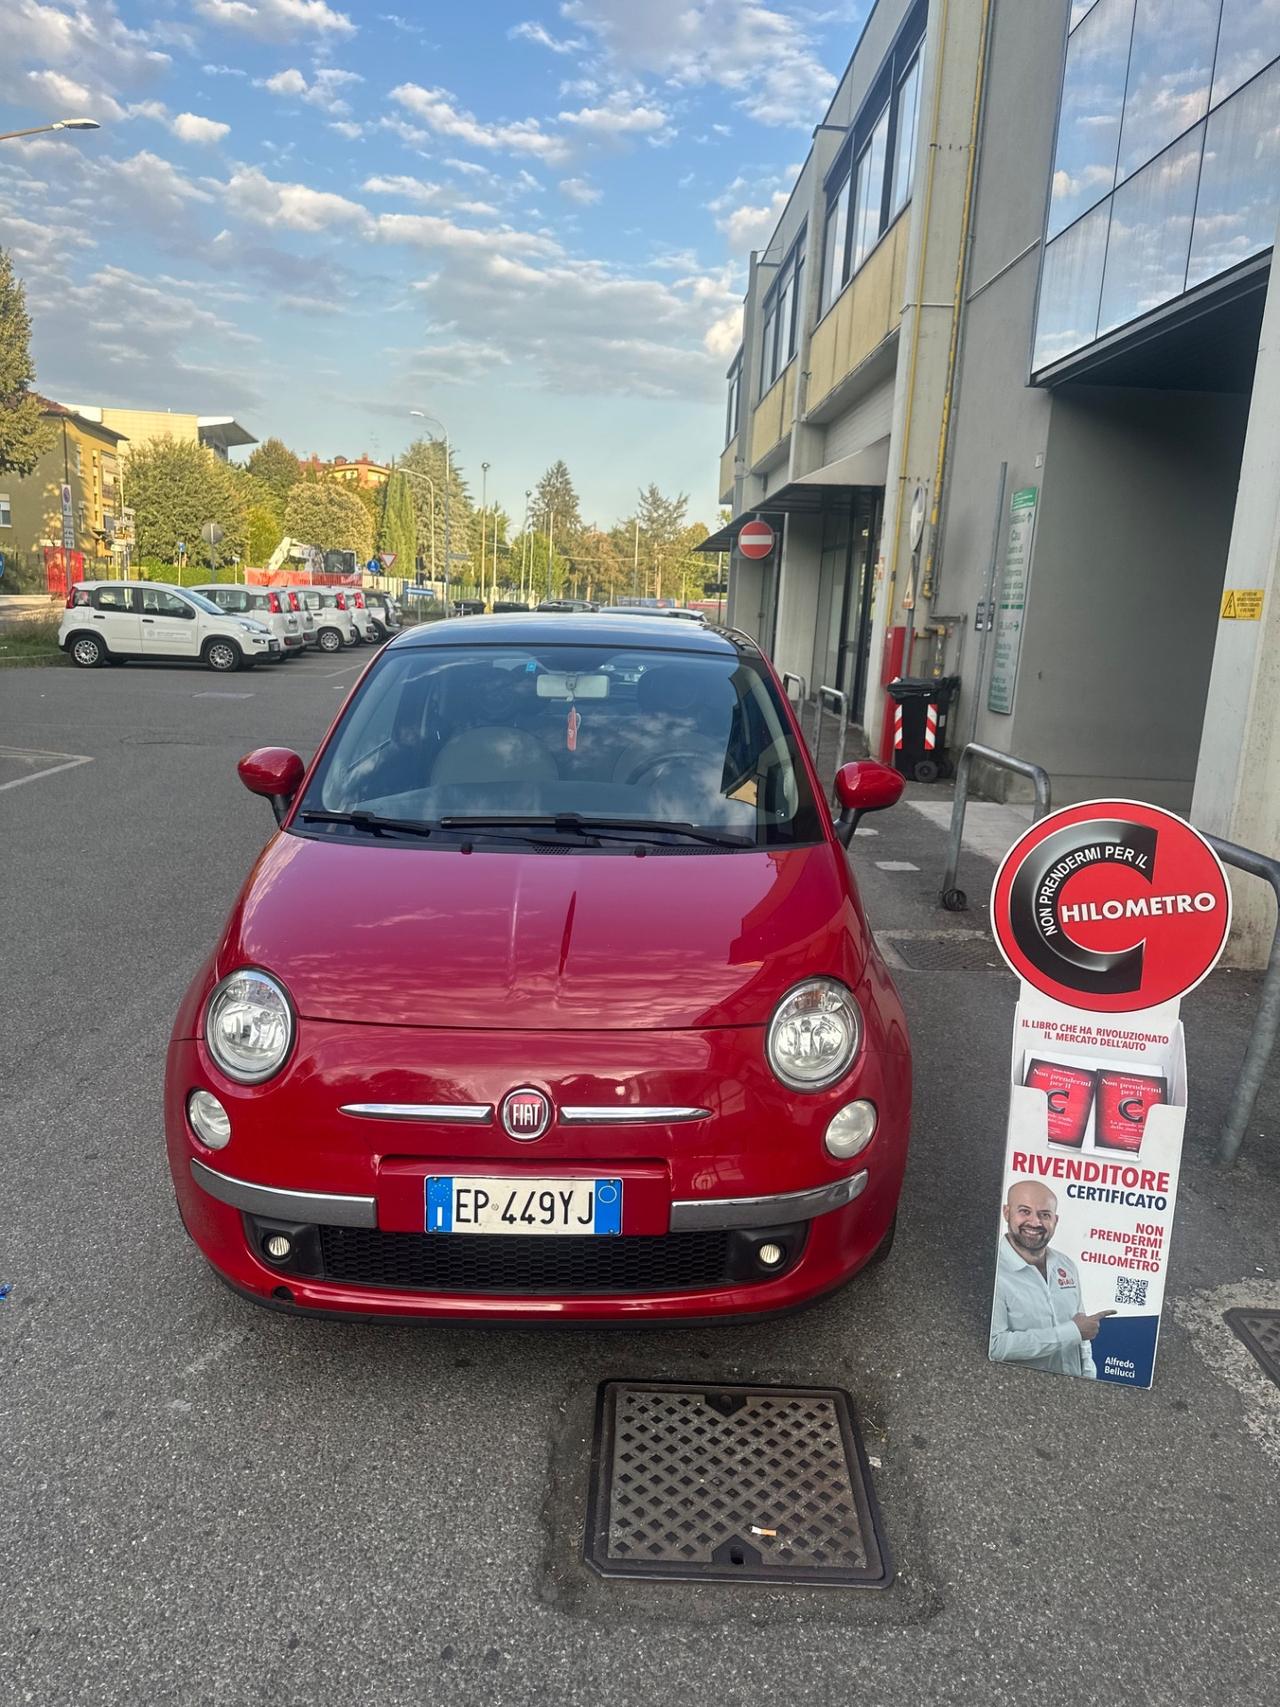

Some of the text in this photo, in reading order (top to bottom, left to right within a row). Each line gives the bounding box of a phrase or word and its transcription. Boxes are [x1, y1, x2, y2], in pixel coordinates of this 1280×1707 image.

[1039, 846, 1148, 936] NON PRENDERMI PER IL
[1022, 1019, 1169, 1044] IL LIBRO CHE HA RIVOLUZIONATO
[1044, 1031, 1052, 1040] IL
[1056, 1032, 1098, 1045] MERCATO
[513, 1104, 540, 1126] FIAT
[1012, 1152, 1170, 1193] RIVENDITORE
[456, 1189, 490, 1224] EP
[501, 1190, 594, 1225] 449YJ
[1066, 1184, 1167, 1211] CERTIFICATO
[1090, 1228, 1163, 1249] PRENDERMI
[1136, 1223, 1164, 1237] NON
[1081, 1251, 1160, 1273] CHILOMETRO
[1124, 1246, 1161, 1261] PER IL
[1104, 1365, 1136, 1379] Bellucci
[1105, 1356, 1134, 1369] Alfredo
